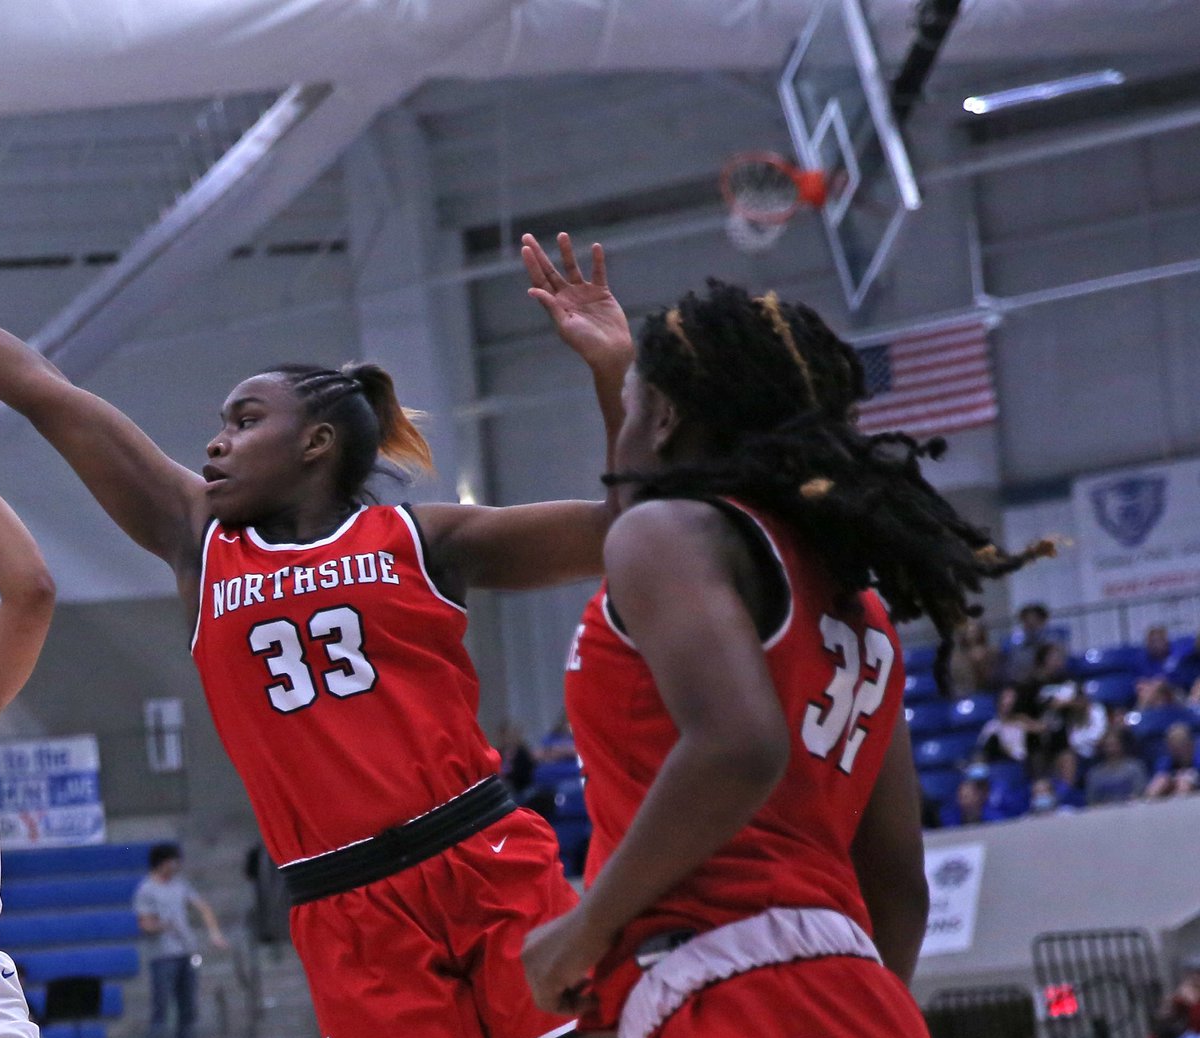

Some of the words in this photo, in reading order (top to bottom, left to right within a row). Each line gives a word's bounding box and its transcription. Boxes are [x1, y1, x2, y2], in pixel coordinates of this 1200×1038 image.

[212, 550, 400, 619] NORTHSIDE
[248, 603, 378, 716] 33
[800, 613, 895, 775] 32
